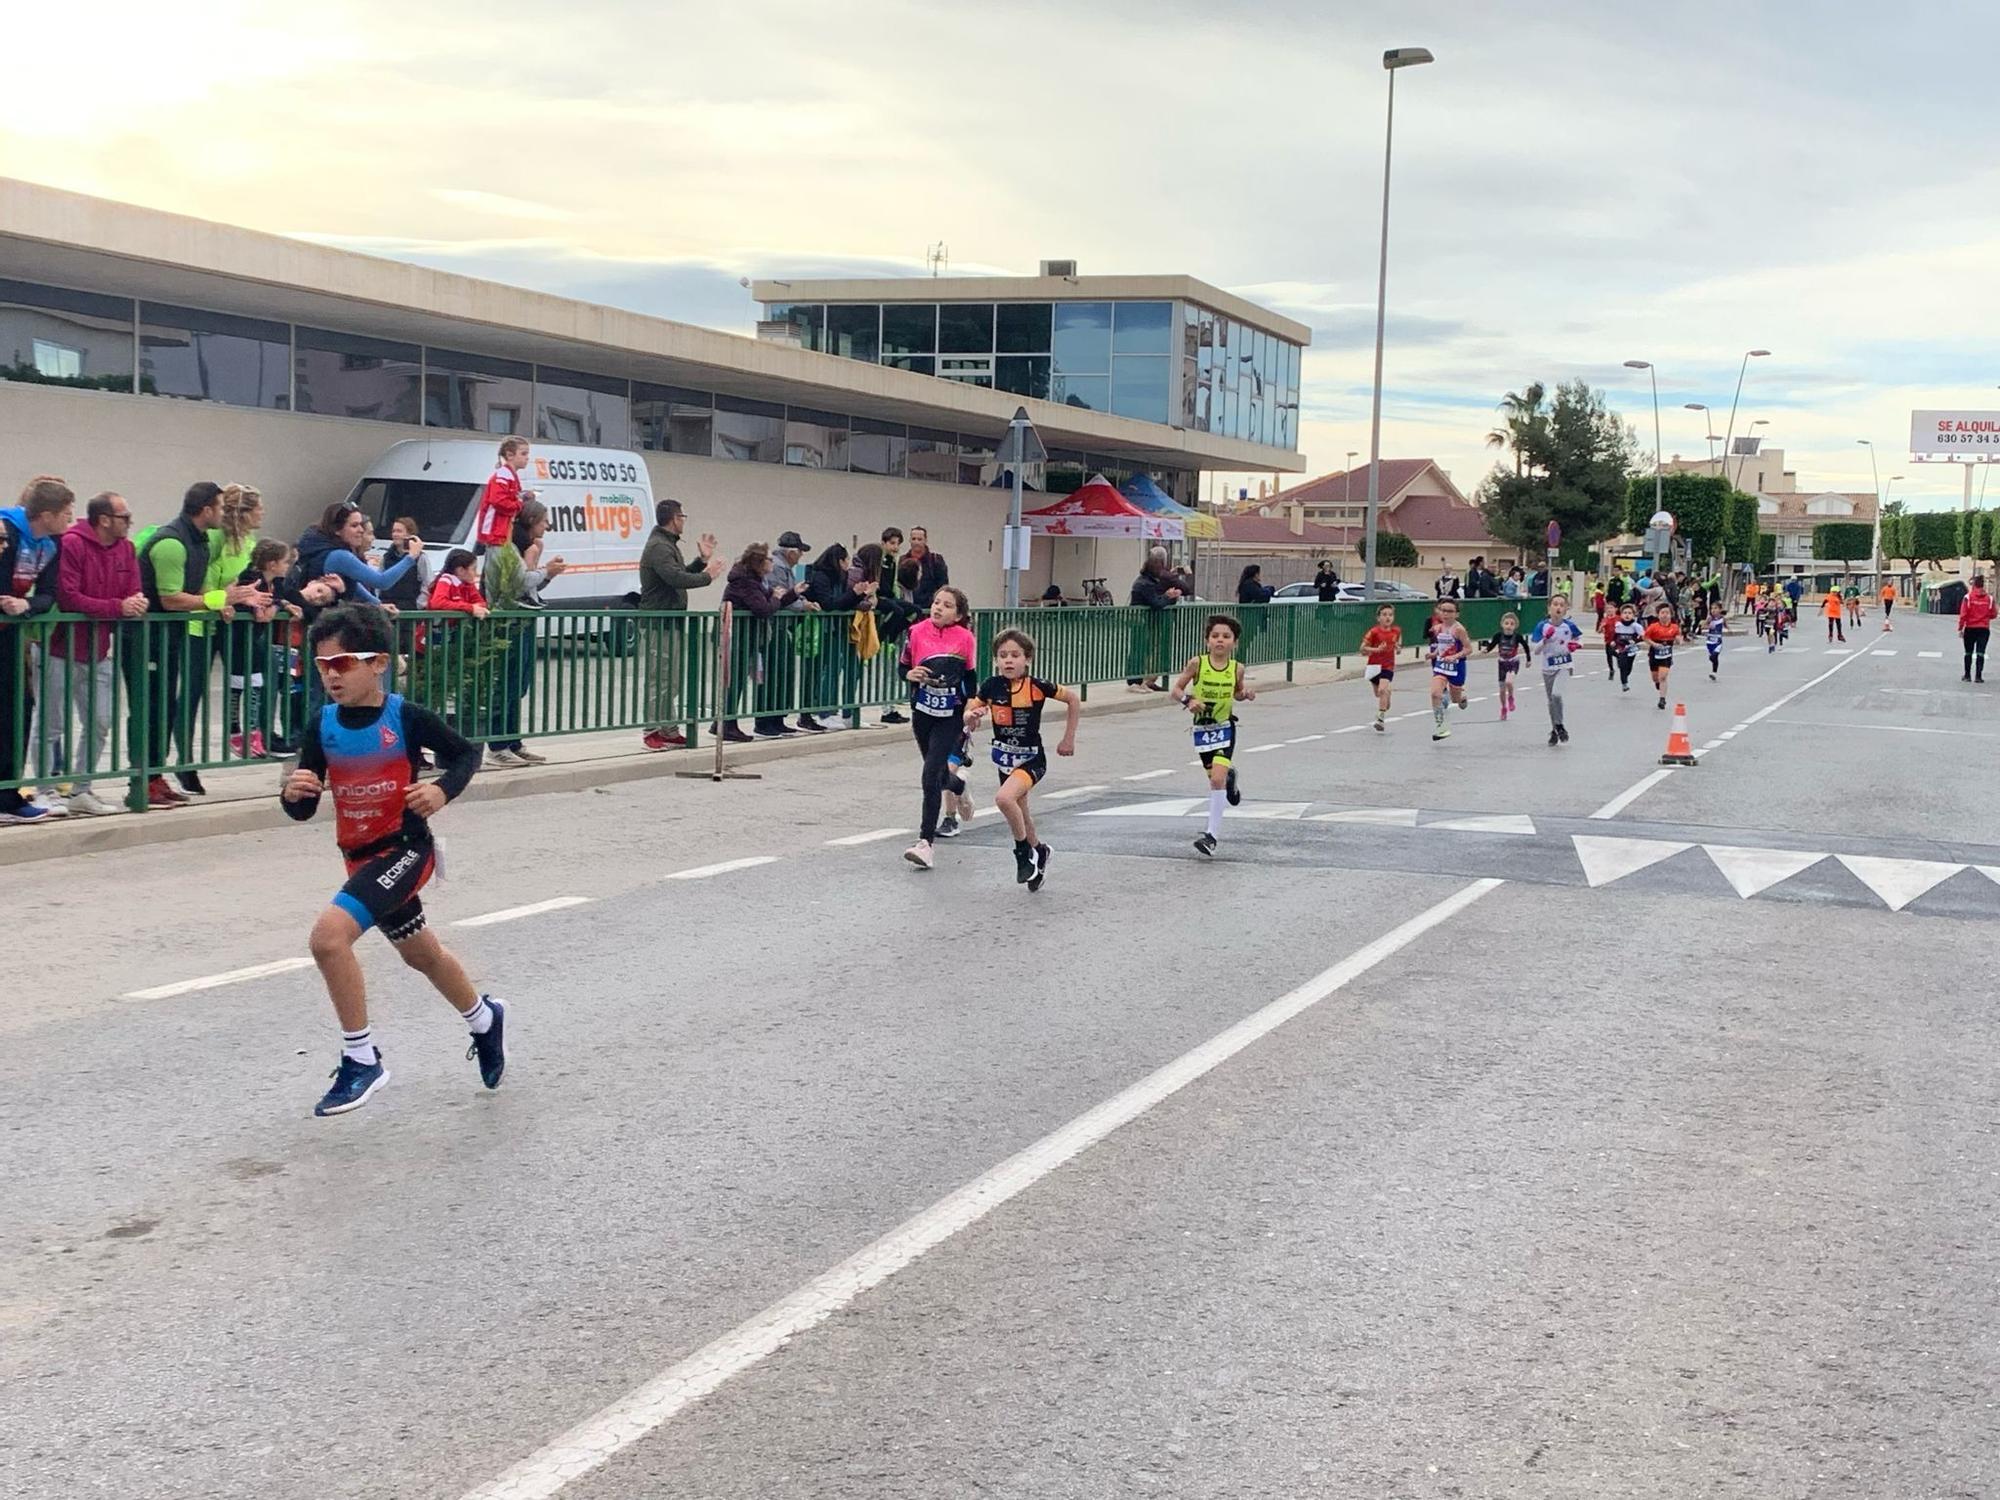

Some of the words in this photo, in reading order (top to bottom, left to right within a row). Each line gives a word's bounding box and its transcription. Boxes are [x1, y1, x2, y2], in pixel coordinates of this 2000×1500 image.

[1938, 420, 1953, 432] SE
[1937, 434, 1957, 443] 630
[1960, 434, 1973, 443] 57
[1976, 434, 1990, 444] 34
[549, 460, 577, 480] 605
[579, 462, 597, 481] 50
[600, 463, 617, 482] 80
[620, 464, 637, 482] 50
[599, 494, 634, 506] mobility
[924, 693, 948, 709] 393
[1201, 730, 1225, 744] 424
[385, 849, 419, 880] COPELE
